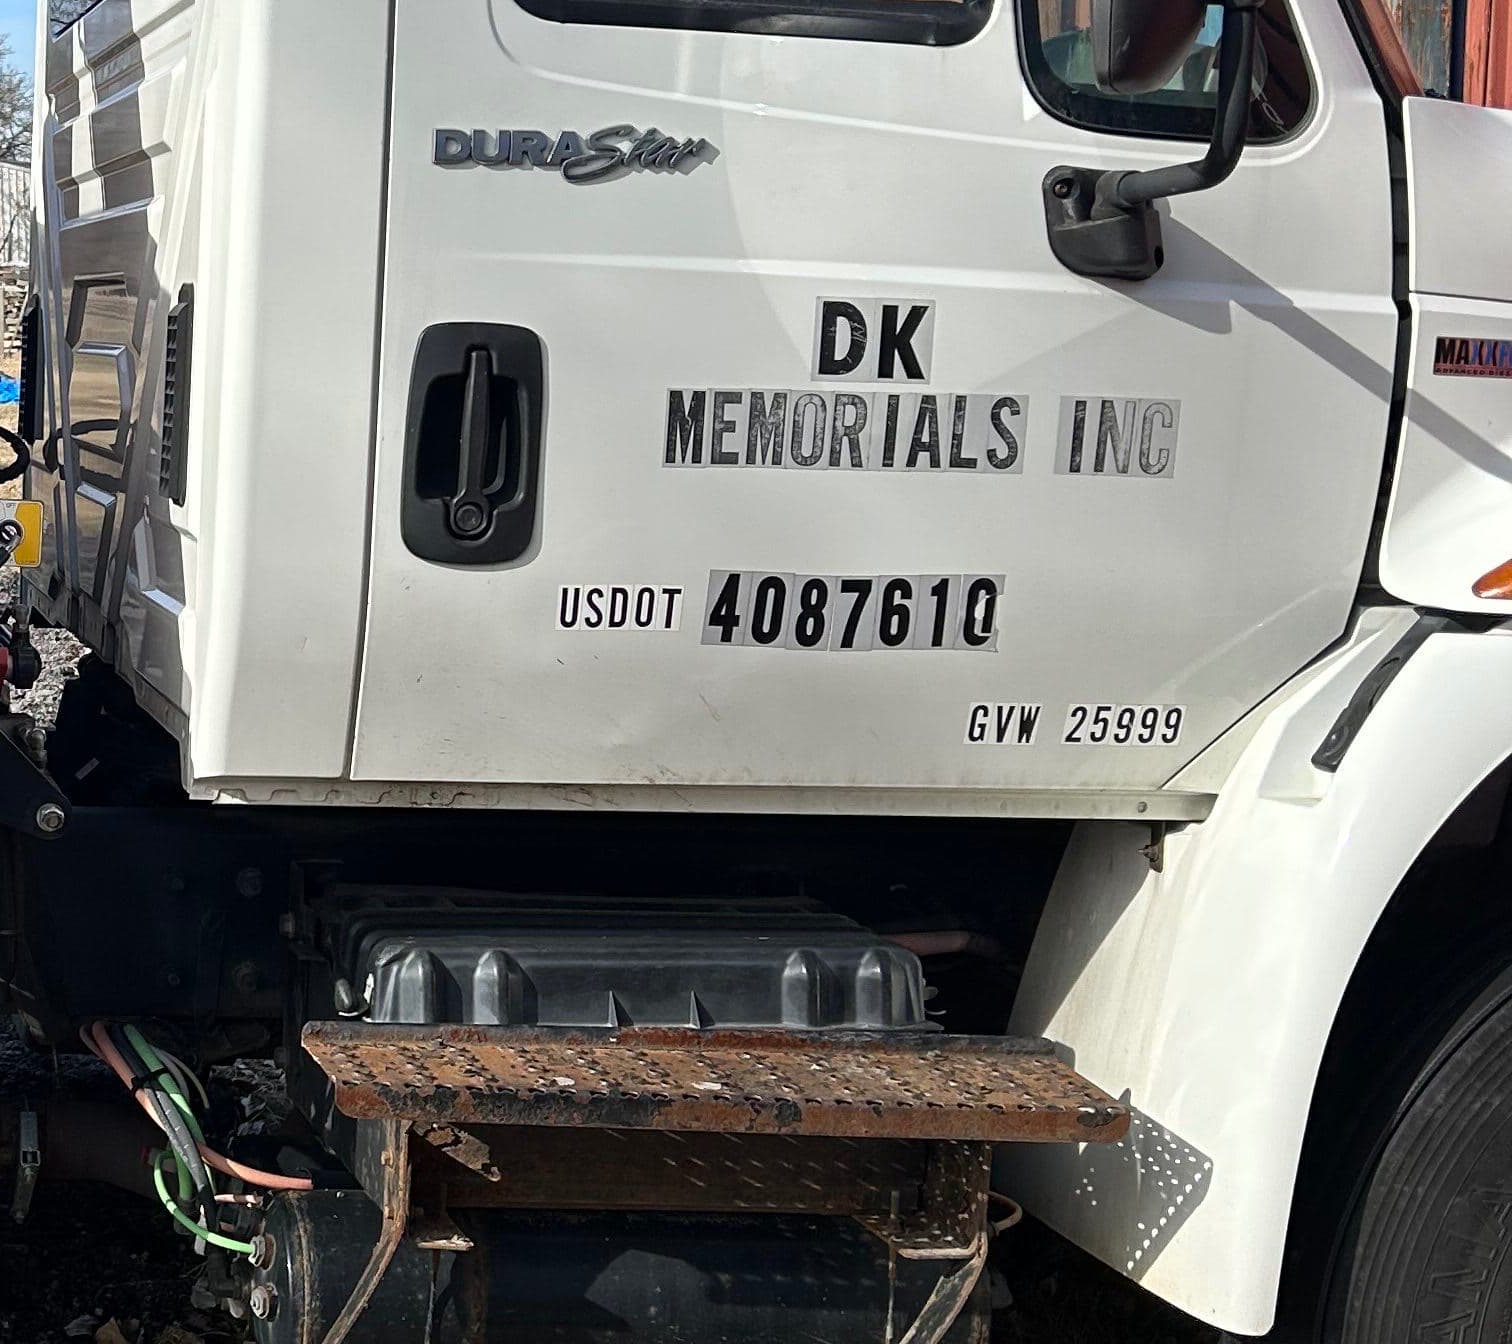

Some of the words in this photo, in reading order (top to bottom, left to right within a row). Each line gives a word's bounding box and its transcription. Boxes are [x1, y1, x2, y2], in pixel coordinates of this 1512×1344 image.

[818, 300, 930, 380] DK
[1434, 338, 1512, 369] MAXXF
[664, 389, 1021, 471] MEMORIALS
[1068, 399, 1175, 475] INC
[559, 586, 683, 630] USDOT
[708, 572, 1001, 649] 4087610
[966, 704, 1042, 744] GVW
[1063, 705, 1184, 745] 25999
